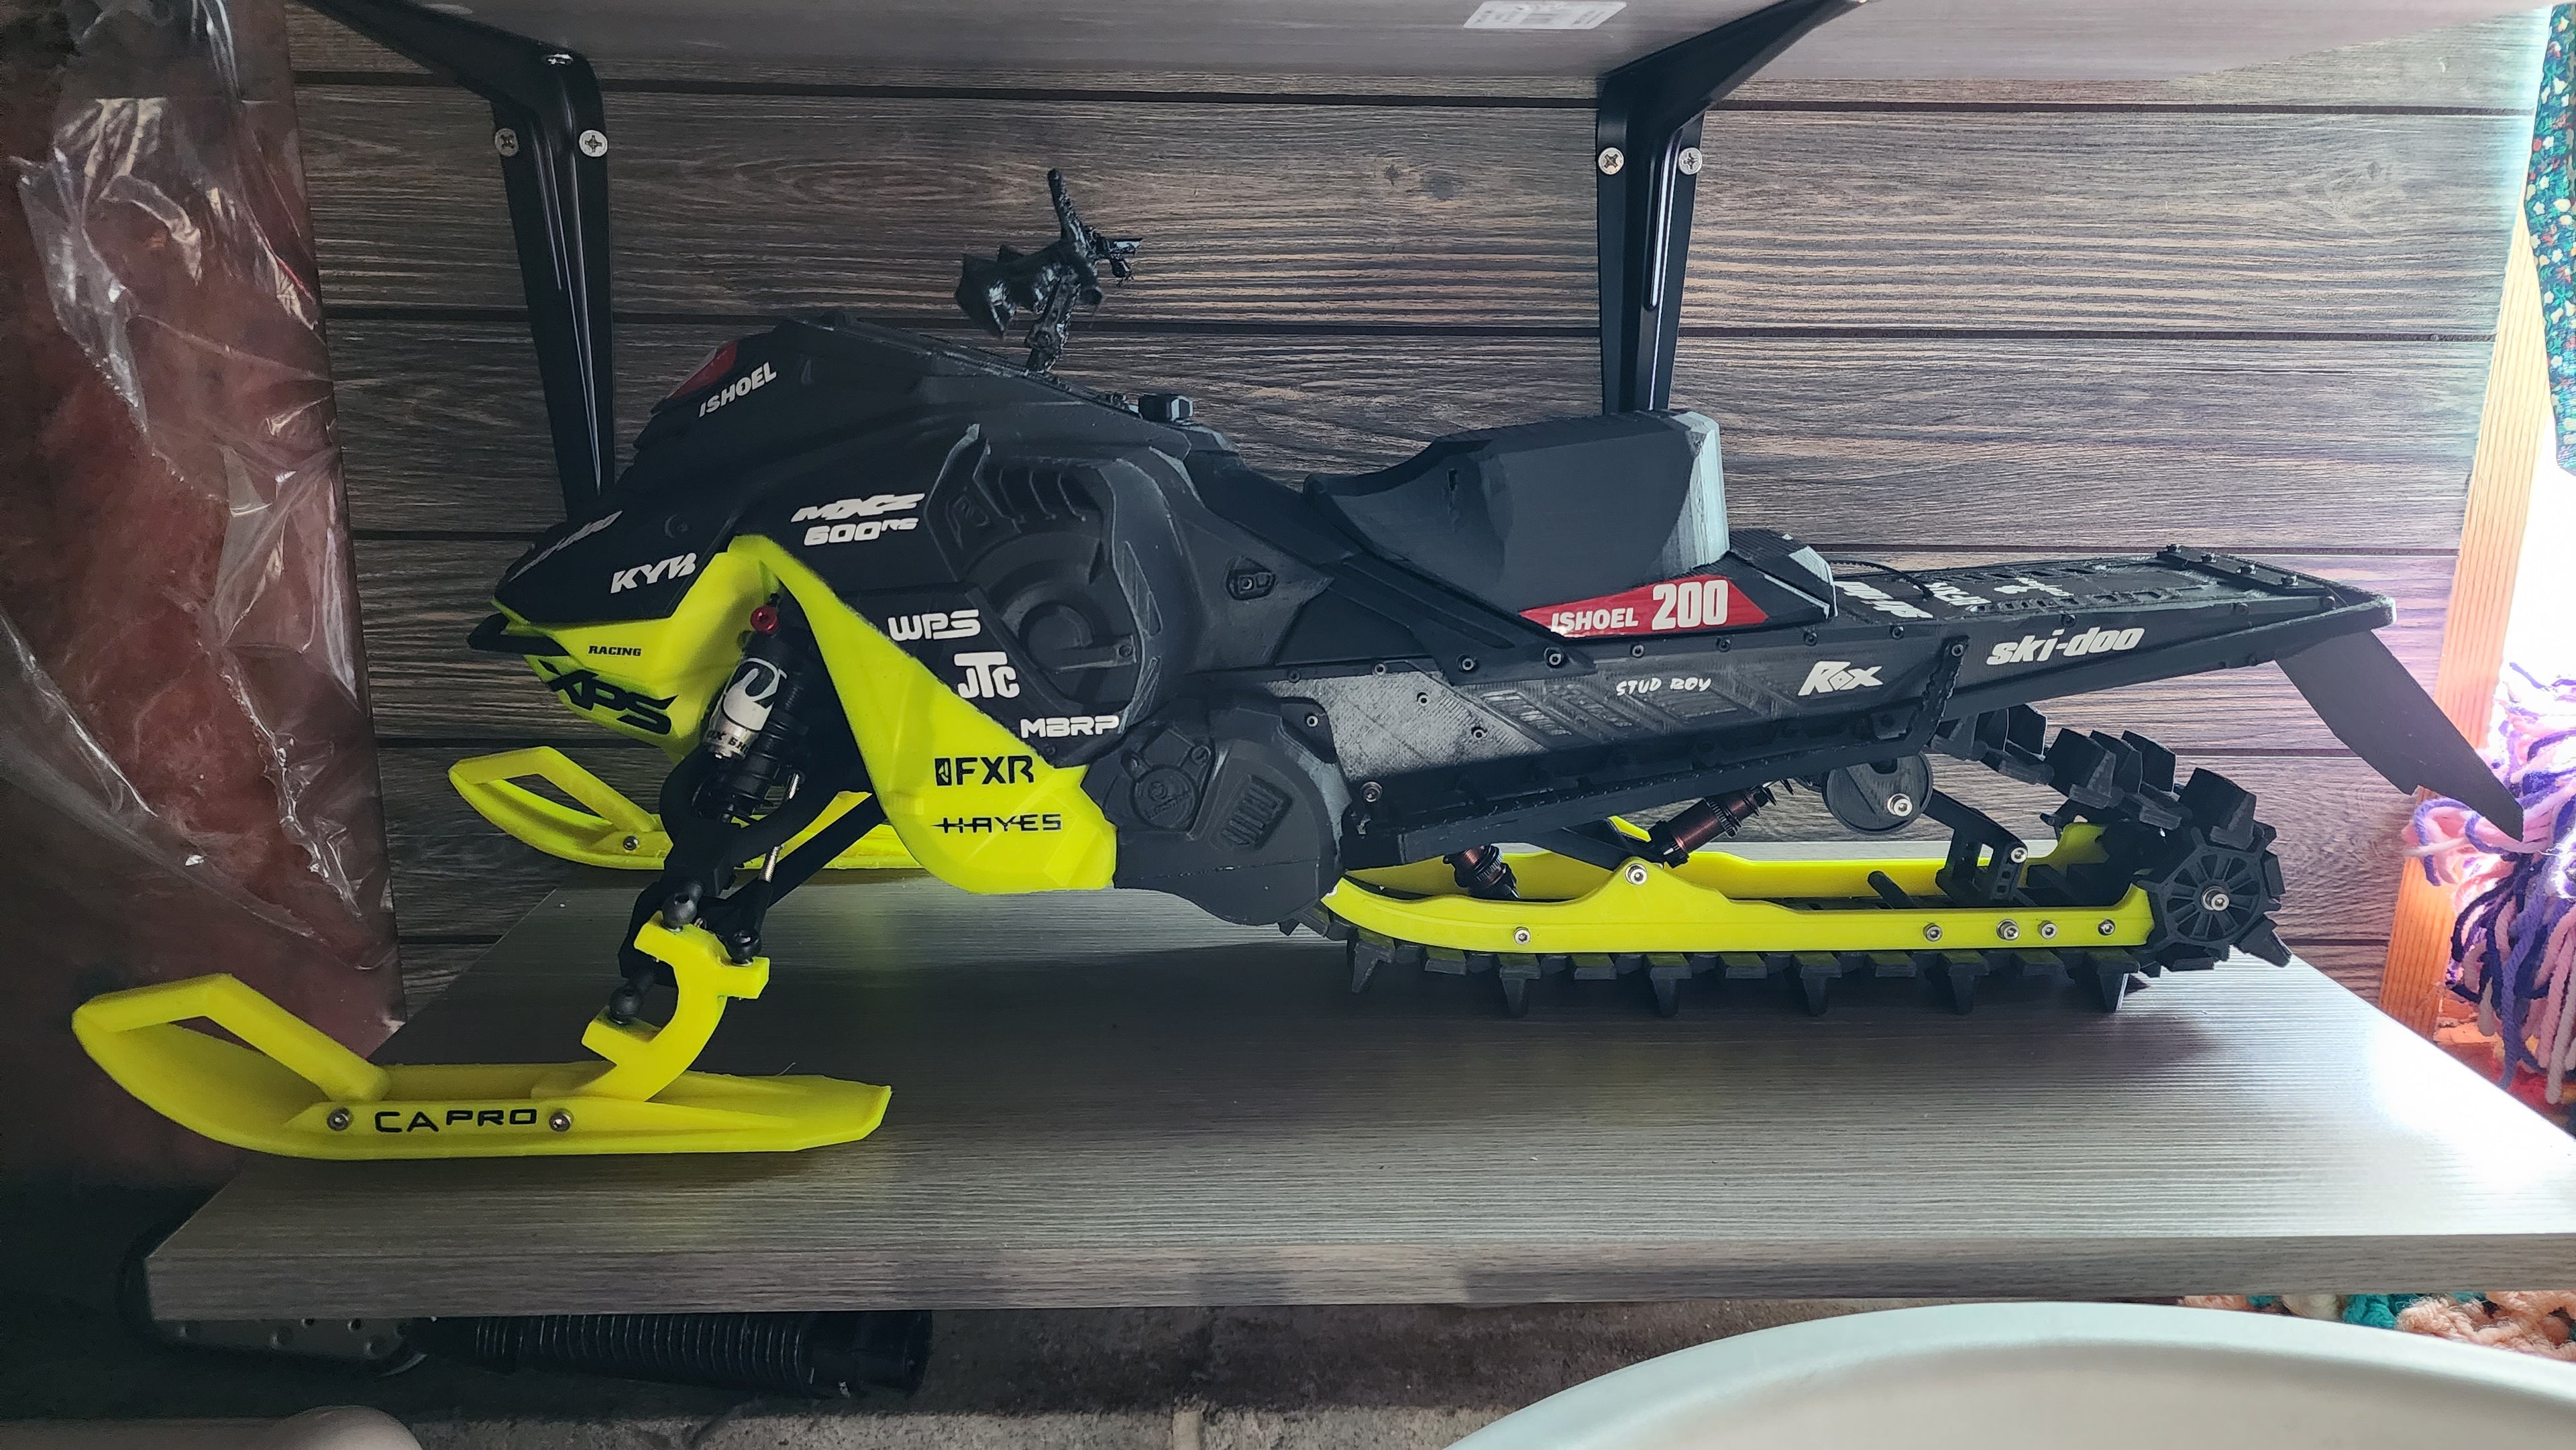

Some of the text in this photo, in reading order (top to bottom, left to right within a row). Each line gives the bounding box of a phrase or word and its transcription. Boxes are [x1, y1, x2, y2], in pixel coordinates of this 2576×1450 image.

[700, 362, 777, 416] ISHOEL
[610, 553, 697, 594] KYB
[1551, 579, 1729, 632] ISHOEL 200
[888, 609, 981, 641] WPS
[588, 645, 642, 657] RACING
[1986, 627, 2145, 665] ski-doo
[1616, 677, 1662, 696] STUD
[1020, 715, 1120, 738] MBRP
[956, 755, 1034, 785] FXR
[931, 814, 1061, 833] HAYES
